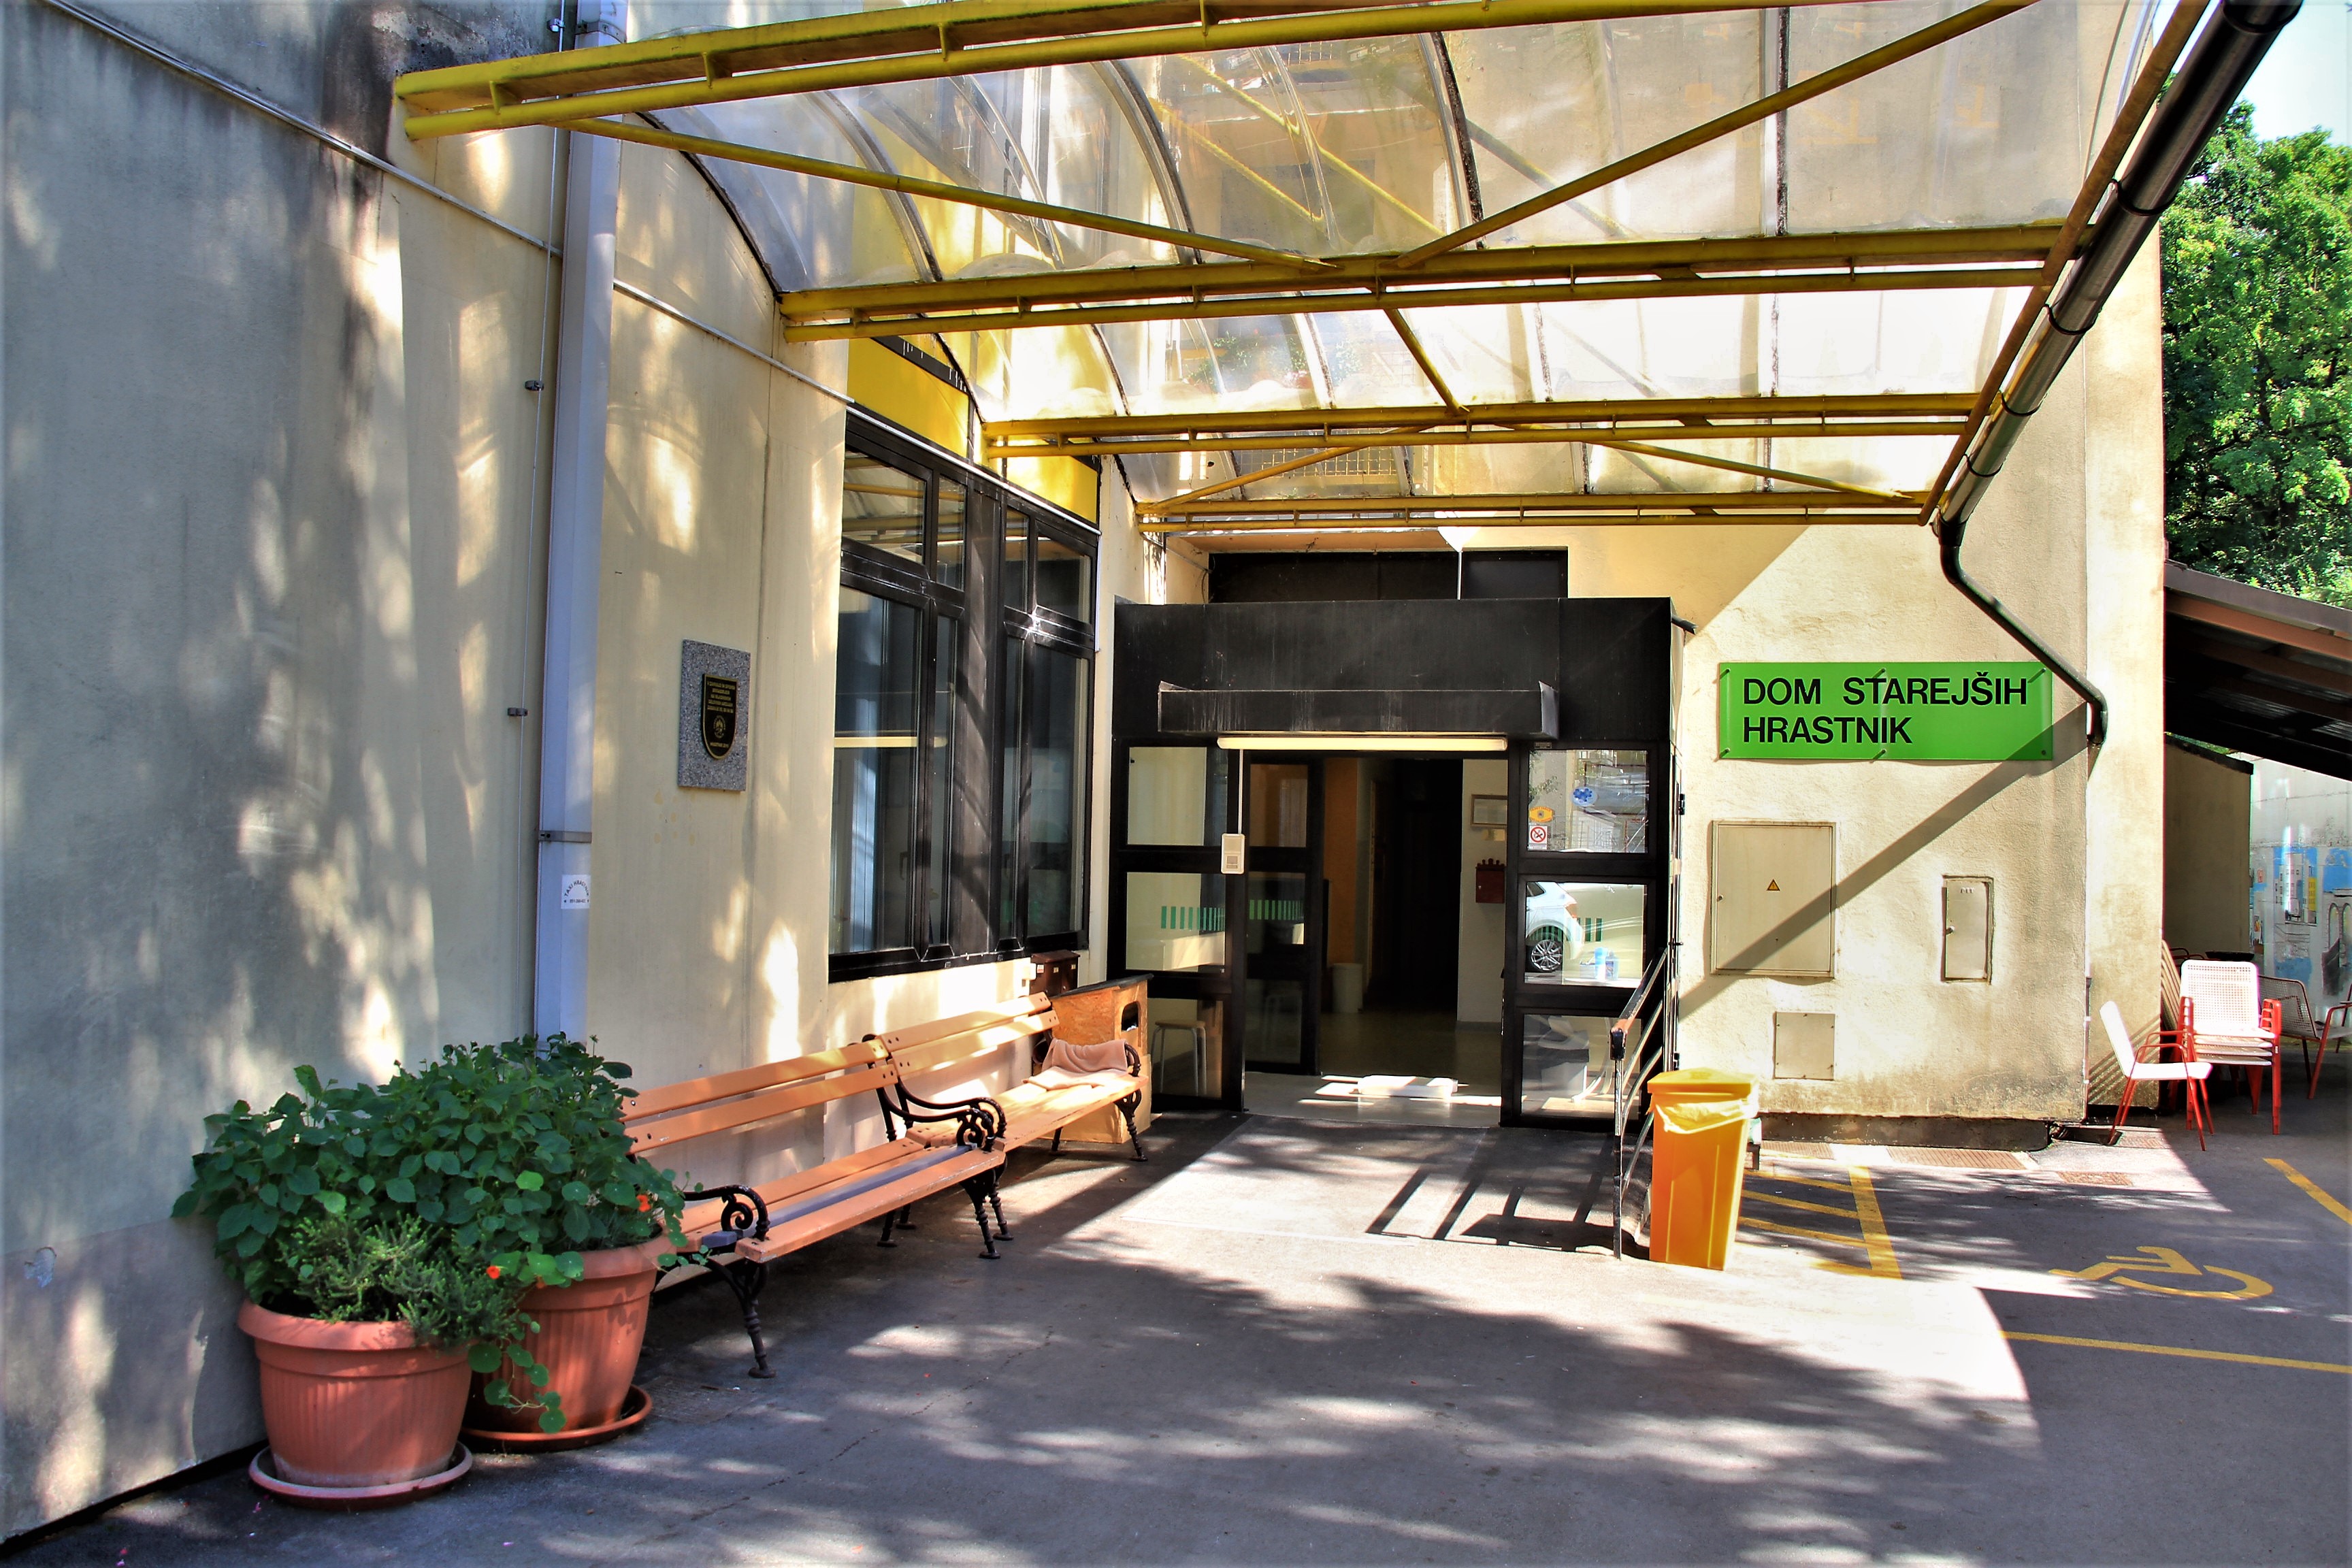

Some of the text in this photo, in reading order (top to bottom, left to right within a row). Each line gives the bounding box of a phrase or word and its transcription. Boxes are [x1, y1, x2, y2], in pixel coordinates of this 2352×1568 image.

[1744, 672, 2027, 705] DOM STAREJŠIH
[1744, 716, 1912, 744] HRASTNIK
